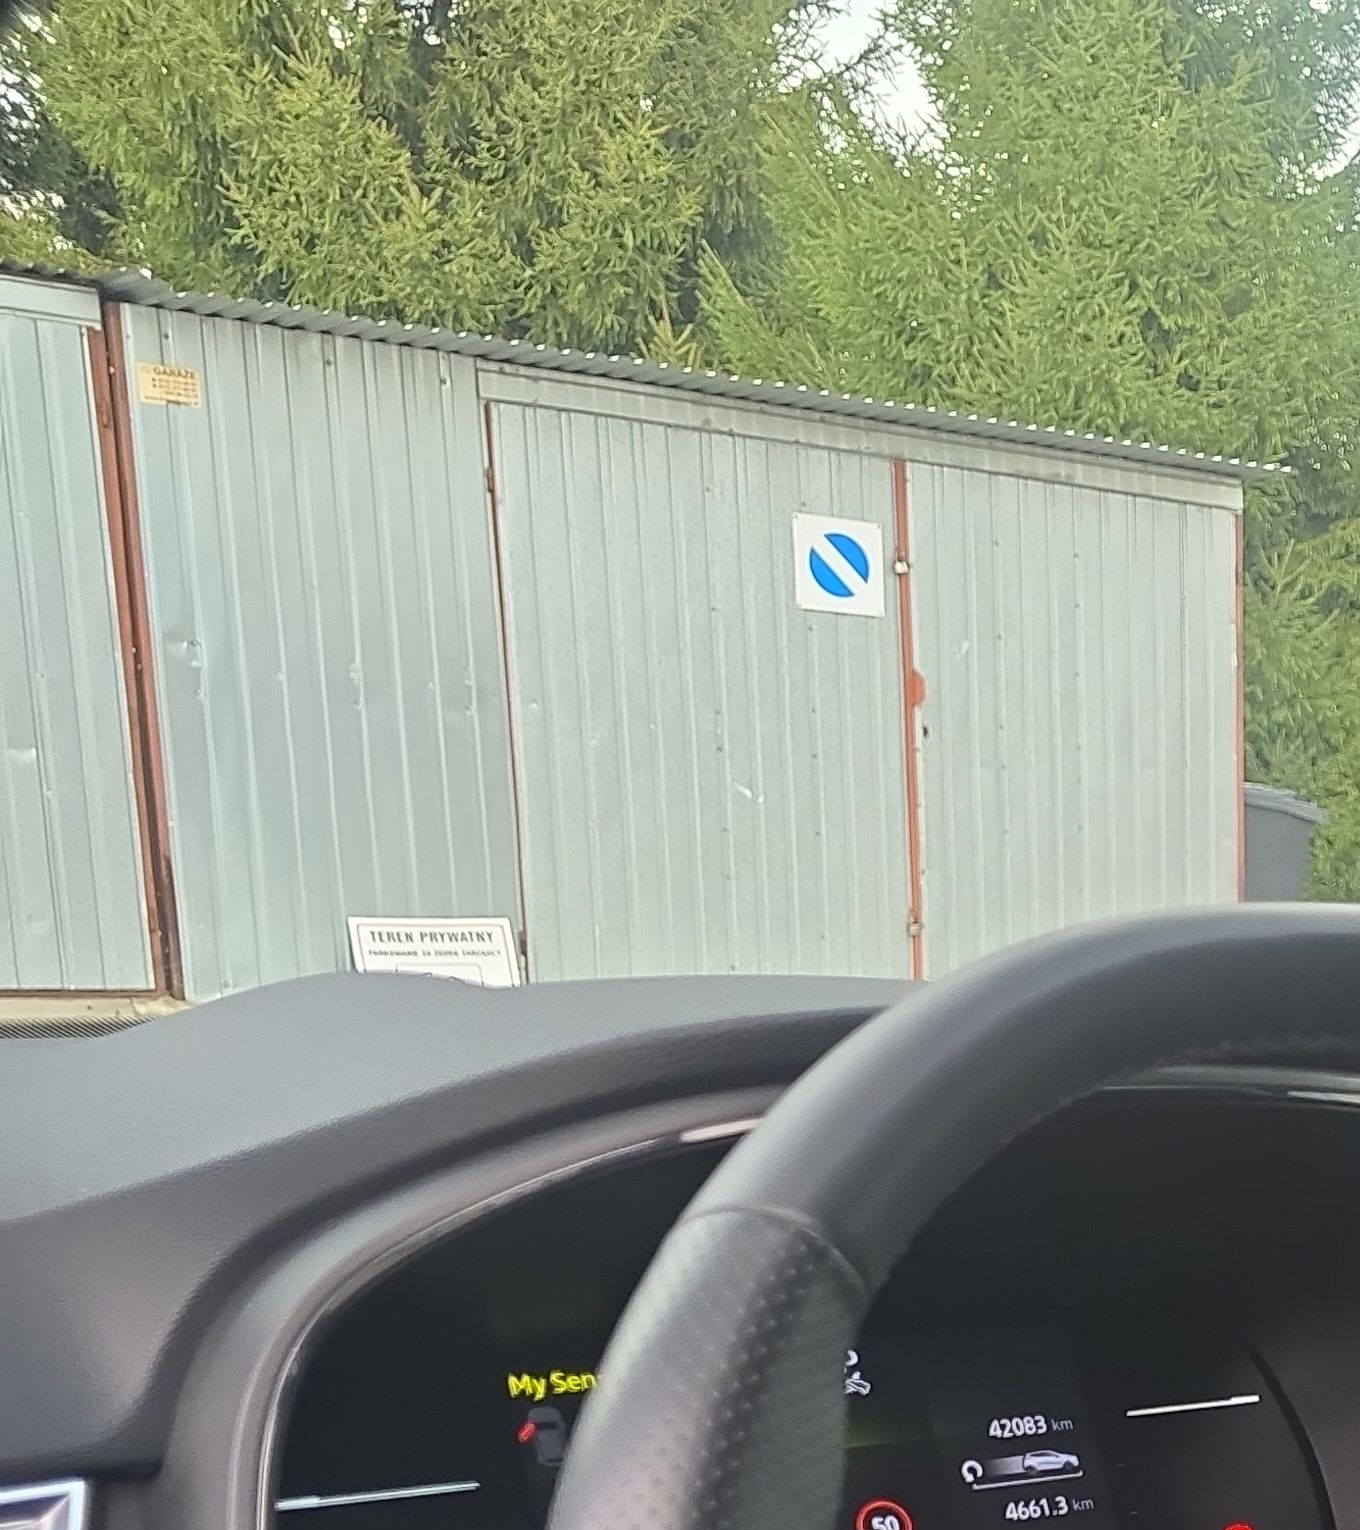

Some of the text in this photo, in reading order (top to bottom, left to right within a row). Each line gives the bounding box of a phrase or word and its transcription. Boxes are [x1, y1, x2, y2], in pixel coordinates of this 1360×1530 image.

[370, 930, 493, 943] TEREN PRYWATNY
[508, 1370, 598, 1402] My Sen
[989, 1414, 1074, 1438] 42083 km
[1005, 1495, 1095, 1521] 4661.3 km
